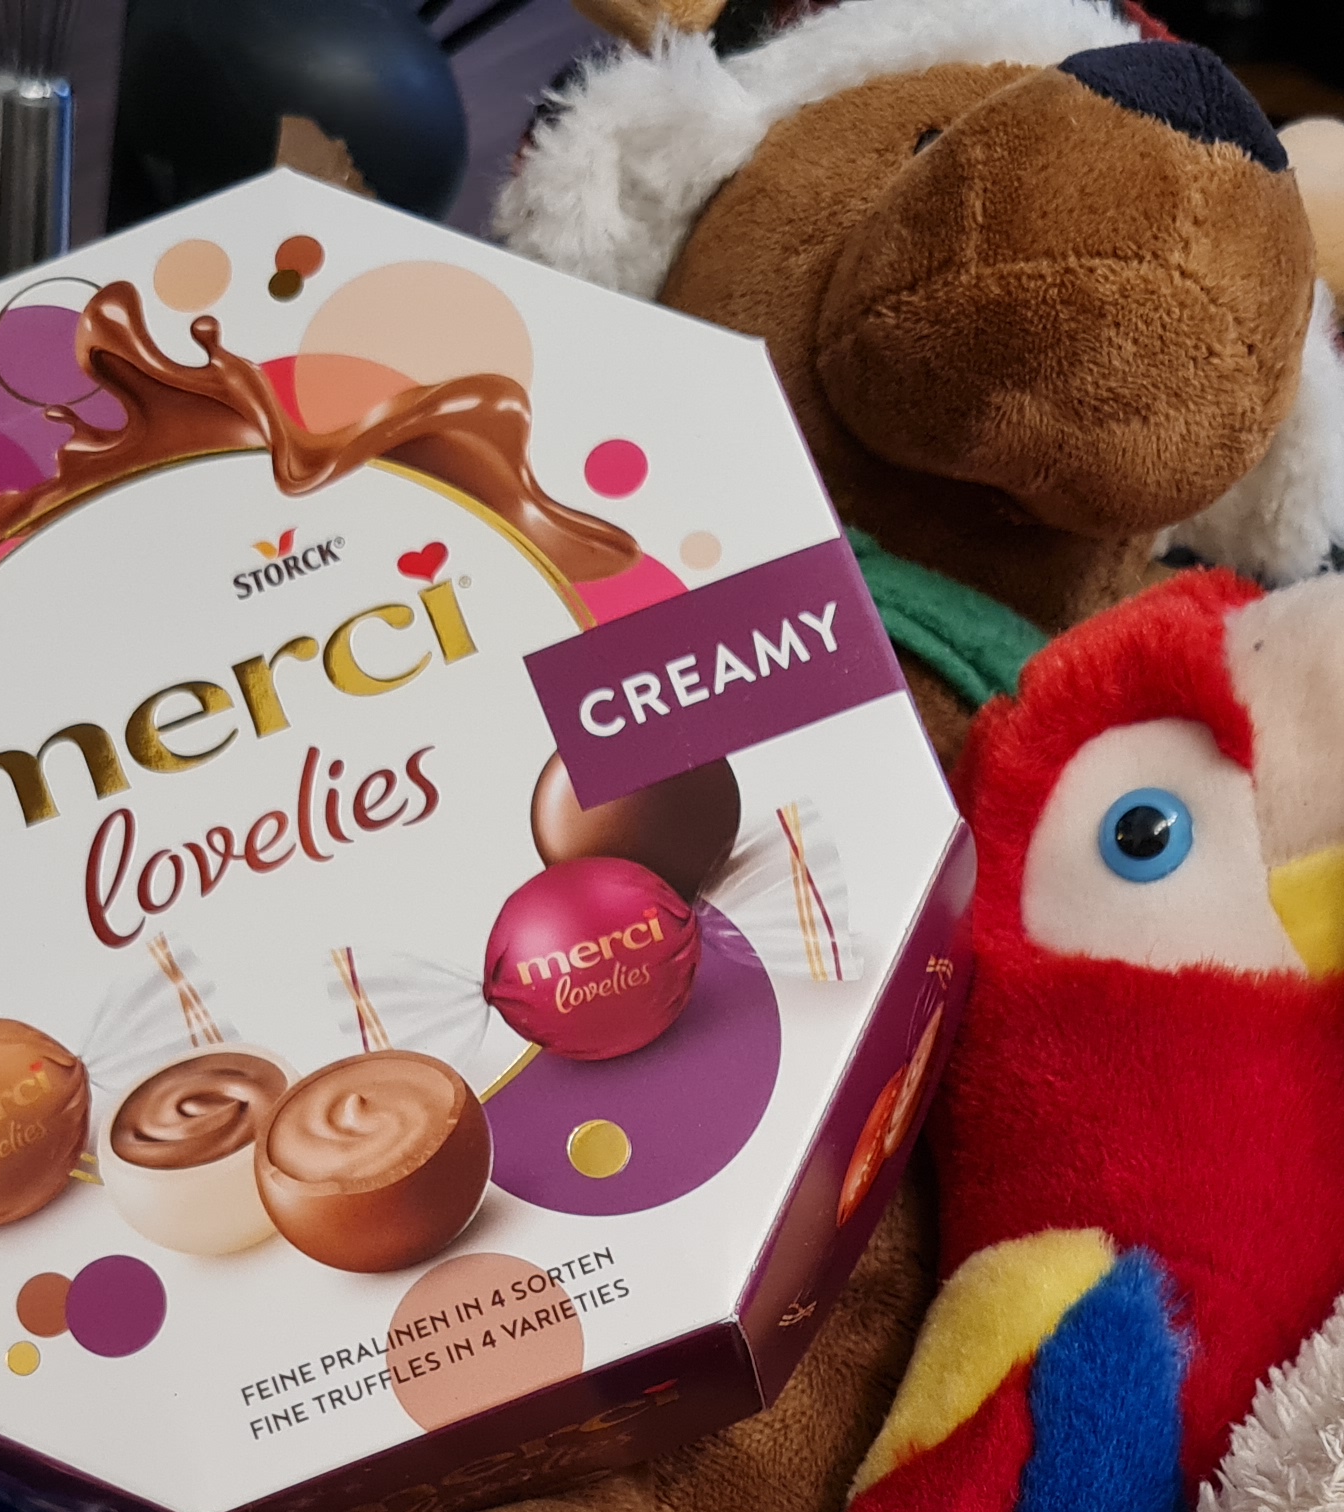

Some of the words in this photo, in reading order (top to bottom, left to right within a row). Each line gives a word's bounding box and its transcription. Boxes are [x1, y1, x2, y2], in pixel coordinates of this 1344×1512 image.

[232, 539, 340, 600] STORCK
[578, 600, 838, 738] CREAMY
[85, 745, 440, 950] lovelies
[516, 907, 664, 985] merci
[556, 960, 652, 1014] lovelies
[240, 1361, 317, 1407] FEINE
[319, 1309, 452, 1376] PRALINEN
[454, 1296, 485, 1324] IN
[490, 1288, 507, 1309] 4
[511, 1246, 616, 1301] SORTEN
[249, 1401, 310, 1441] FINE
[311, 1351, 442, 1416] TRUFFLES
[445, 1337, 475, 1365] IN
[481, 1329, 498, 1350] 4
[500, 1277, 631, 1341] VARIETIES
